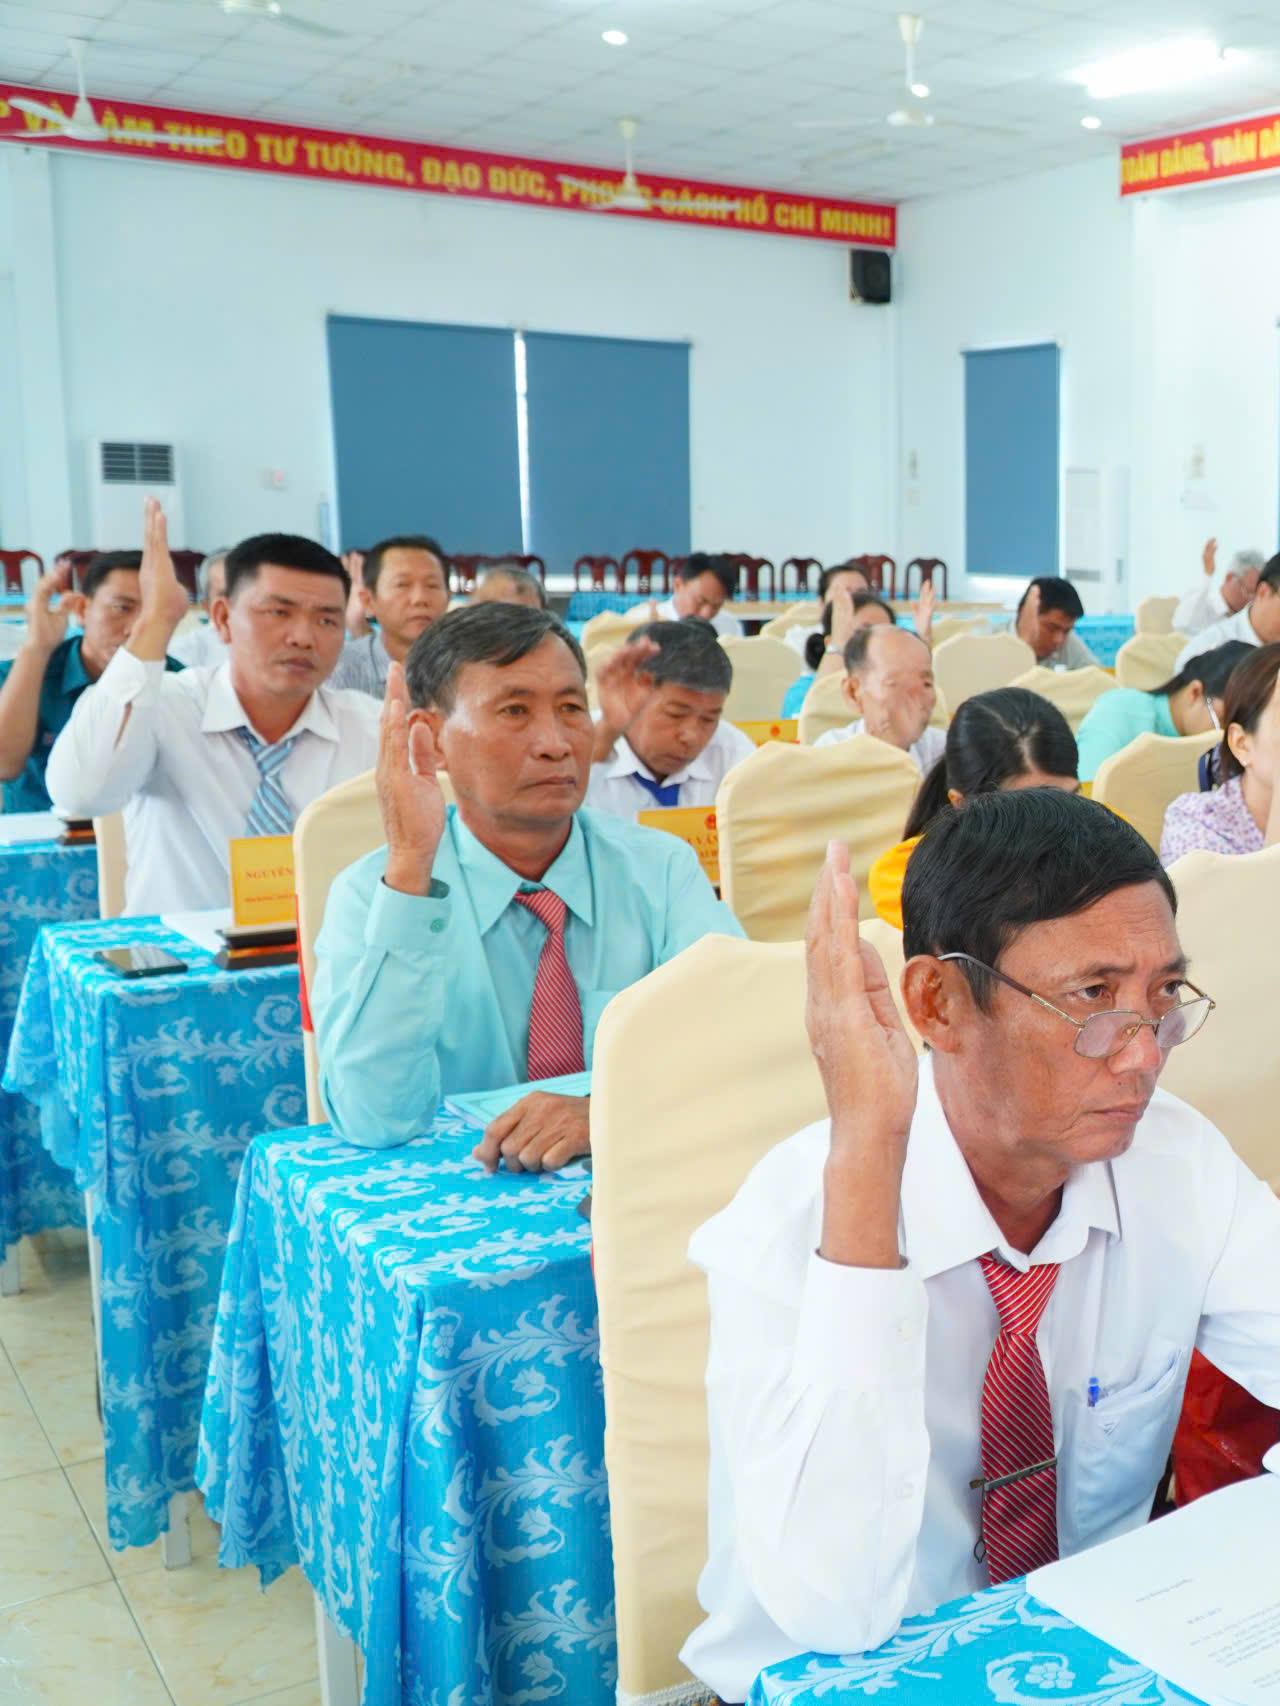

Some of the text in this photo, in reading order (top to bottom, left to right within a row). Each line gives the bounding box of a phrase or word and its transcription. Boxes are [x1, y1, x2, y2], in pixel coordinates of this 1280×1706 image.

[255, 134, 299, 166] TƯ
[306, 136, 415, 184] TƯỞNG,
[422, 160, 481, 193] ĐẠO
[488, 162, 555, 202] ĐỨC,
[774, 198, 815, 232] CHÍ
[821, 206, 891, 240] MINH!
